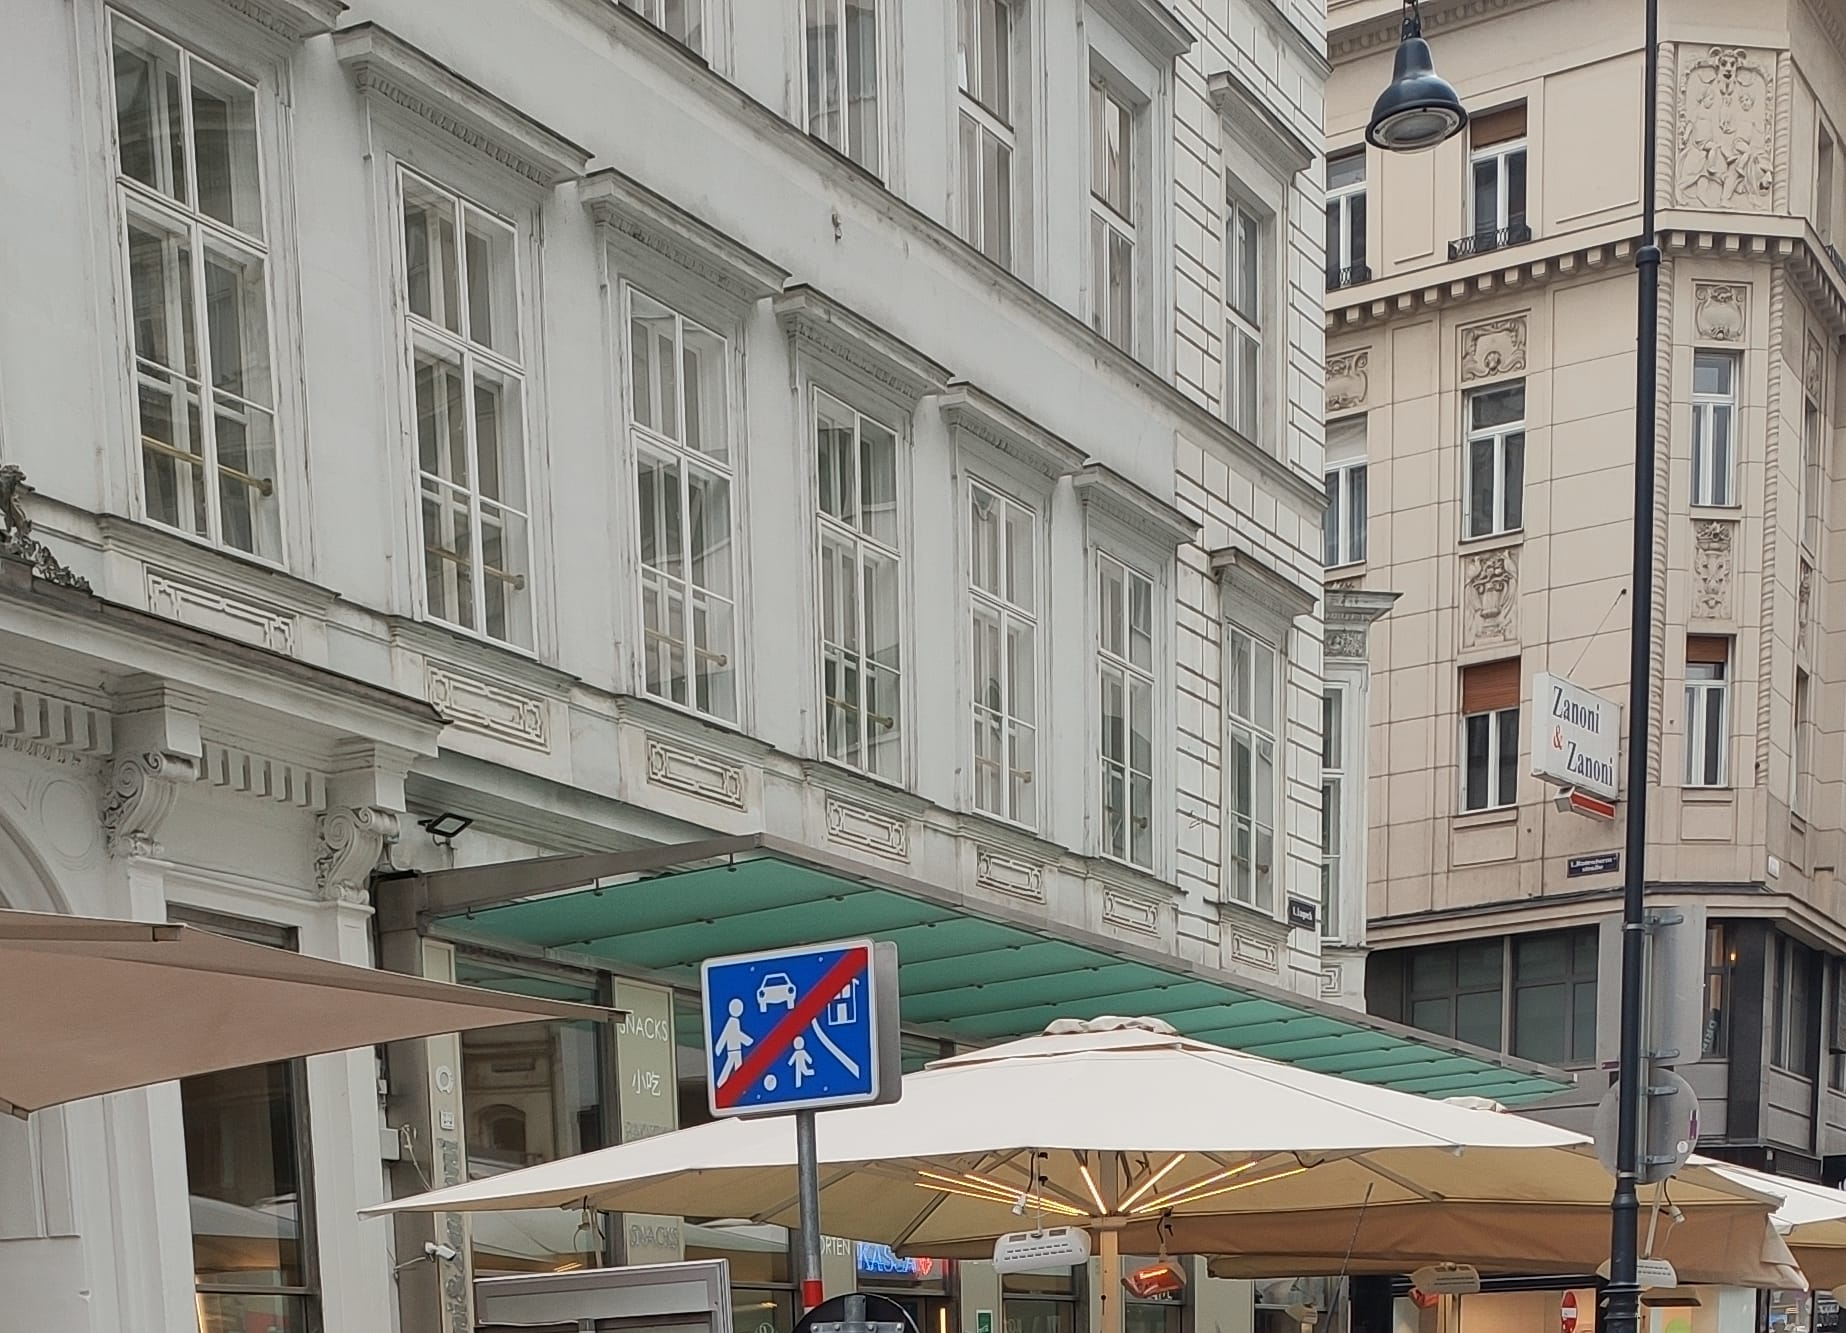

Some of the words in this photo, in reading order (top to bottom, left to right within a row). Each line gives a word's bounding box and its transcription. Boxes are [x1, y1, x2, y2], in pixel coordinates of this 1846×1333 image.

[1552, 685, 1600, 734] Zanoni
[1553, 724, 1563, 750] &
[1566, 740, 1613, 787] Zanoni
[631, 1068, 661, 1096] 小吃
